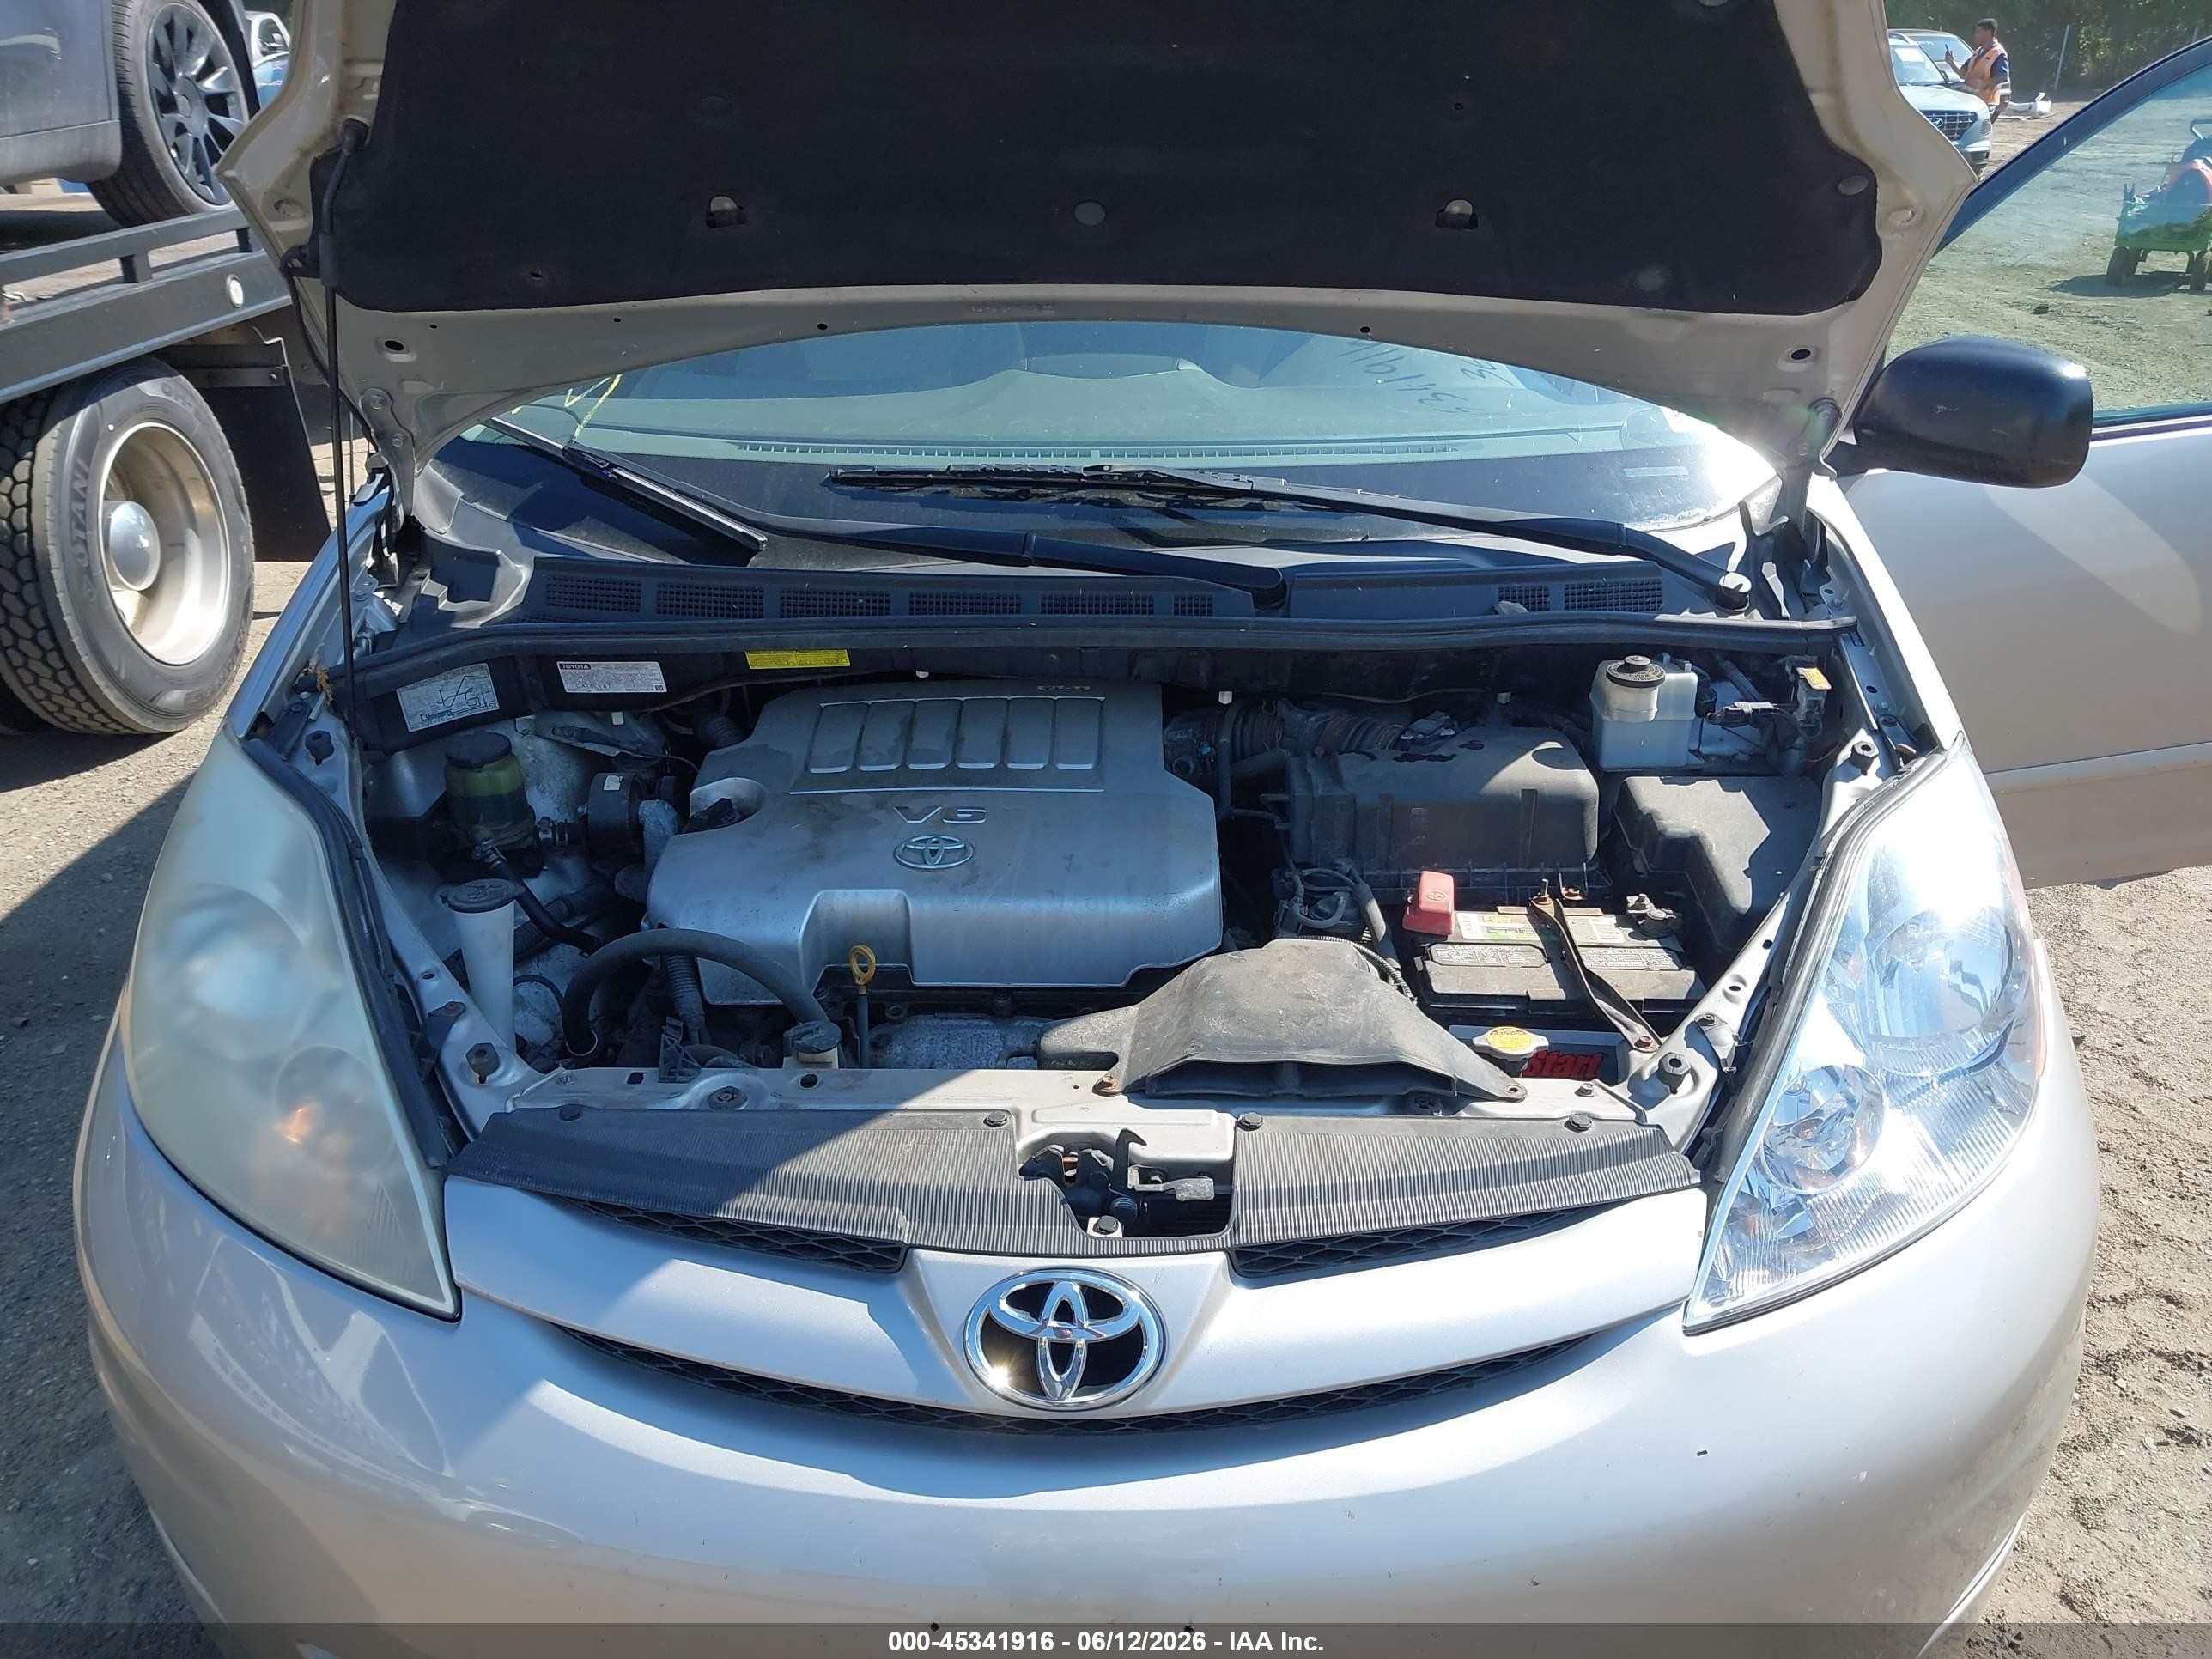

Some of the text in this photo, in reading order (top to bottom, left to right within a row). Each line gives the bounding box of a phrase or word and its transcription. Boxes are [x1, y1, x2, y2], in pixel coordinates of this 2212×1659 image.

[71, 456, 89, 568] OTANI
[892, 805, 987, 825] V6
[1522, 1049, 1603, 1079] Start
